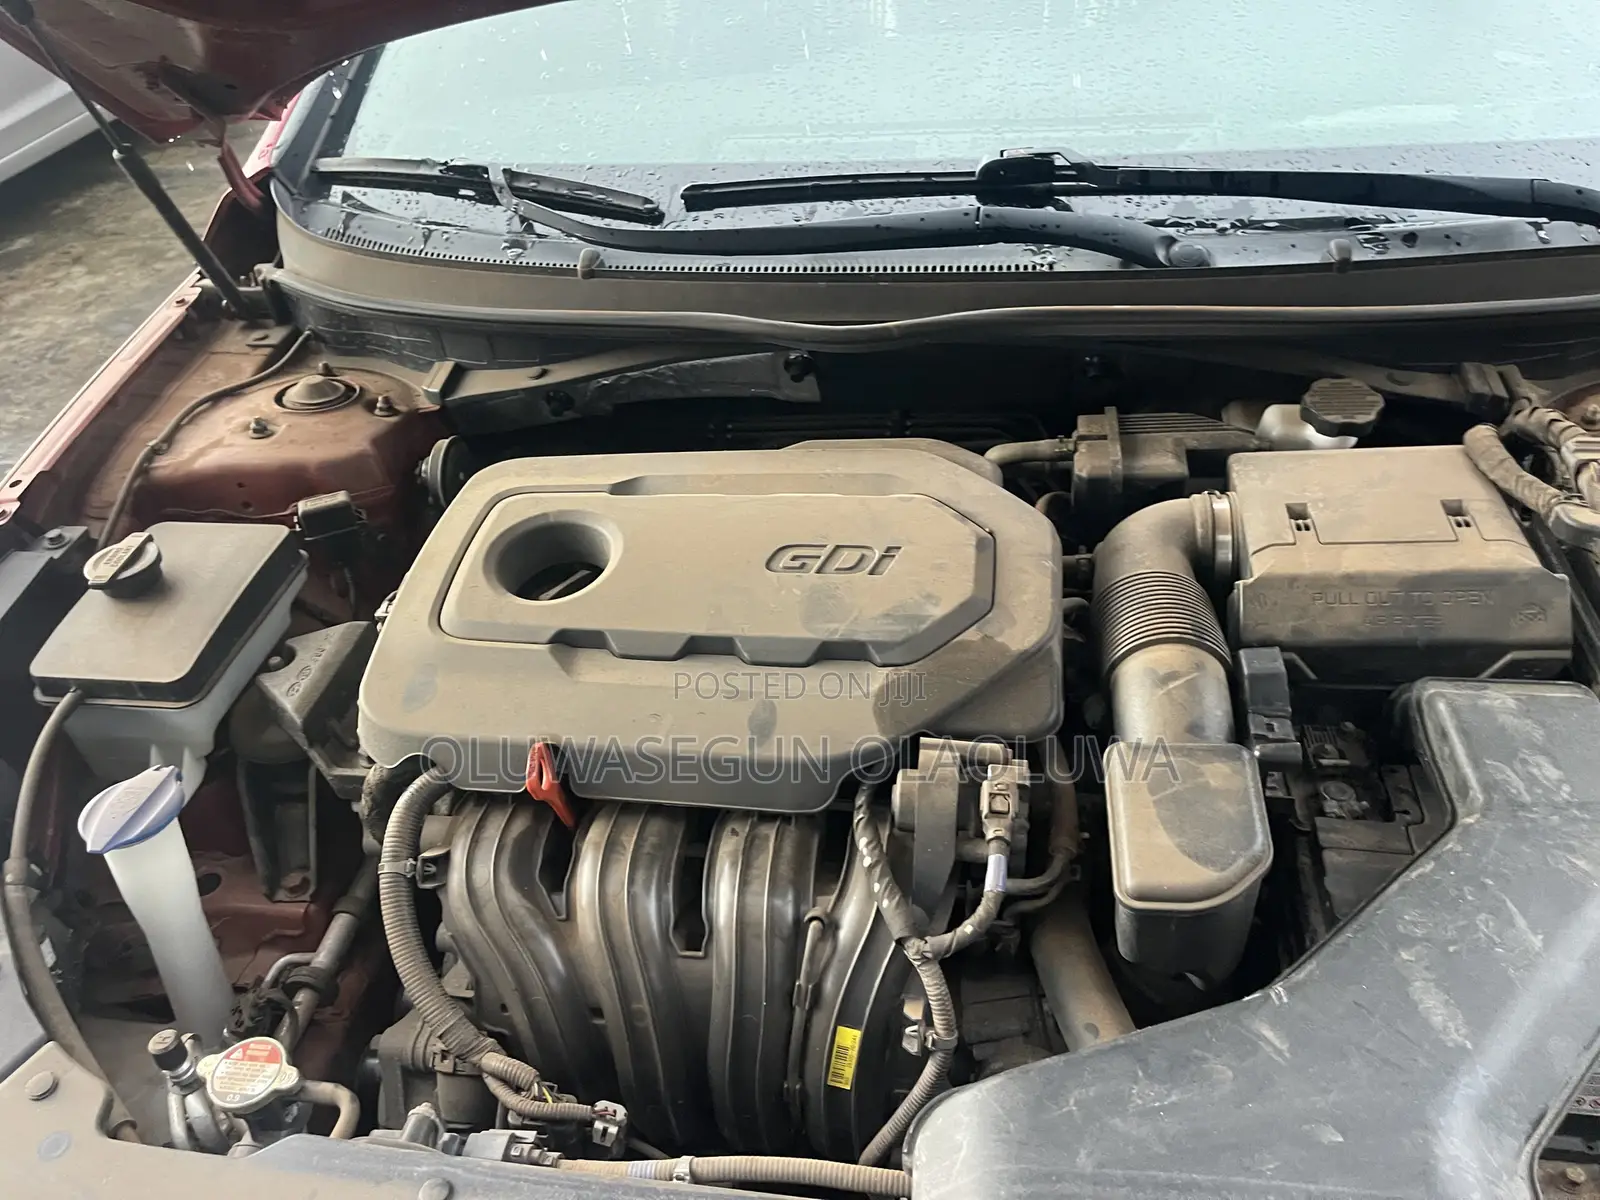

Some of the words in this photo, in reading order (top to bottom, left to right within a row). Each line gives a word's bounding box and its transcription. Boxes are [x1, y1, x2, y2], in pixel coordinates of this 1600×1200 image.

[765, 543, 904, 576] GDi
[1312, 591, 1359, 607] PULL
[1364, 591, 1403, 607] OUT
[1410, 591, 1435, 606] TO
[1442, 591, 1494, 607] OPEN
